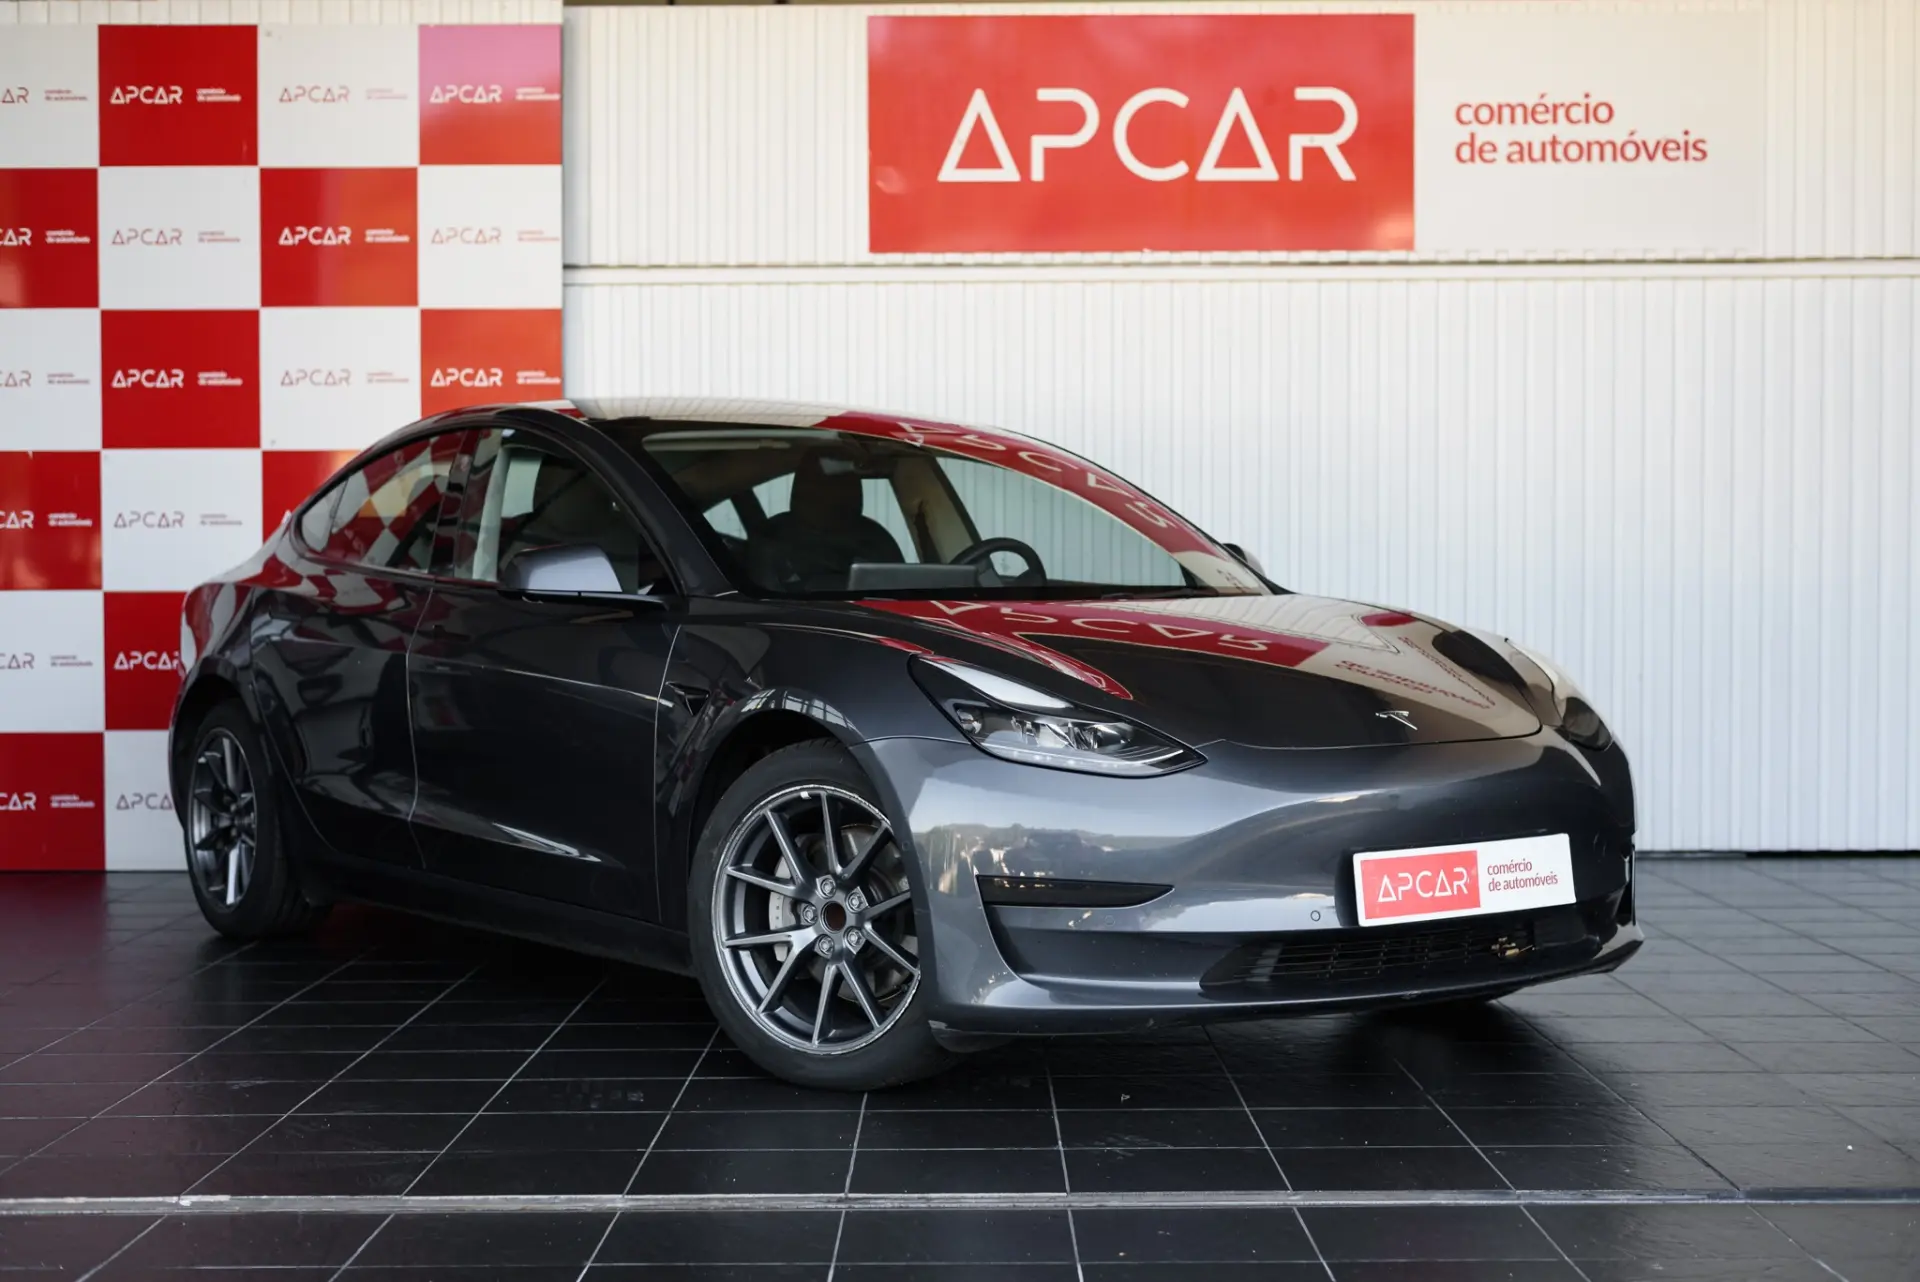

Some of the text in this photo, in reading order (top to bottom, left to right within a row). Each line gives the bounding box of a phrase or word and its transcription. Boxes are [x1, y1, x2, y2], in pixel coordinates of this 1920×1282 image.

[110, 86, 183, 104] APCAR
[279, 85, 350, 103] APCAR
[429, 85, 502, 104] APCAR
[1455, 92, 1615, 126] comércio
[937, 87, 1358, 182] APCAR
[1455, 129, 1708, 164] de automóveis
[111, 228, 182, 246] APCAR
[278, 226, 351, 246] APCAR
[431, 227, 502, 245] APCAR
[112, 369, 184, 388] APCAR
[280, 368, 351, 387] APCAR
[430, 367, 503, 387] APCAR
[113, 511, 184, 529] APCAR
[116, 793, 173, 810] APCA
[1487, 859, 1532, 876] comércio
[1378, 867, 1469, 903] APCAR
[1488, 871, 1559, 892] de automóveis
